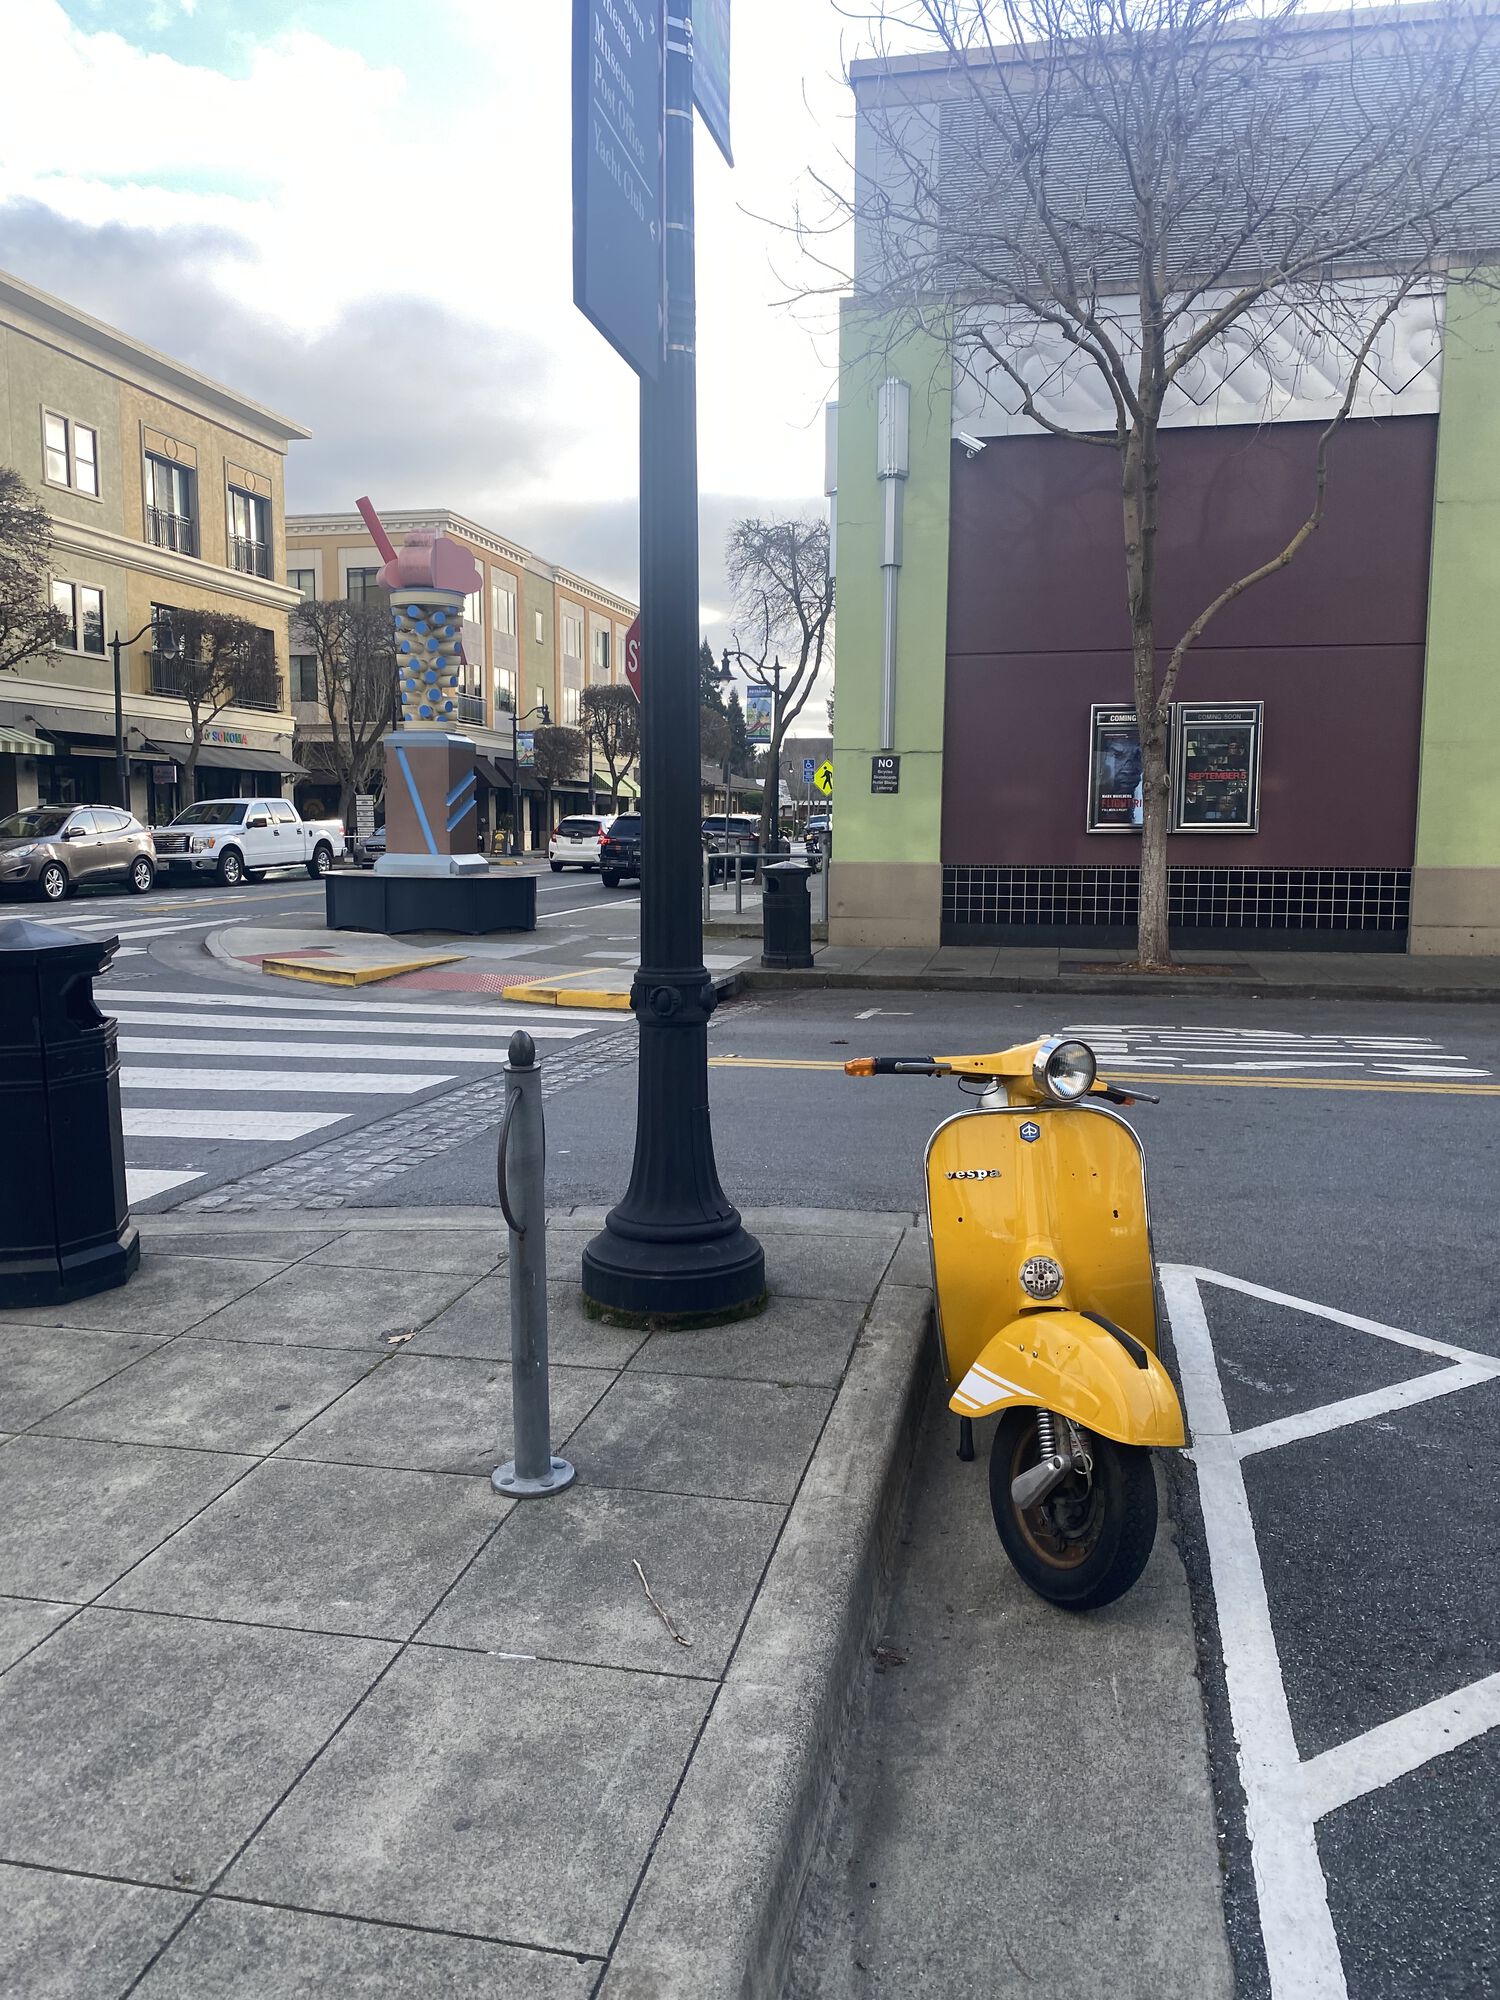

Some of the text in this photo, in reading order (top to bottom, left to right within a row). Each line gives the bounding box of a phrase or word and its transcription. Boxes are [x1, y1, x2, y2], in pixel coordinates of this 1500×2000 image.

[595, 11, 634, 109] Museum
[595, 54, 645, 164] Post Office
[594, 119, 645, 221] Yacht Club
[1110, 714, 1137, 722] COMING
[211, 730, 248, 745] SONOMA
[878, 759, 893, 768] NO
[1187, 771, 1248, 780] SEPTEMBER 5
[944, 1168, 1002, 1181] vespa
